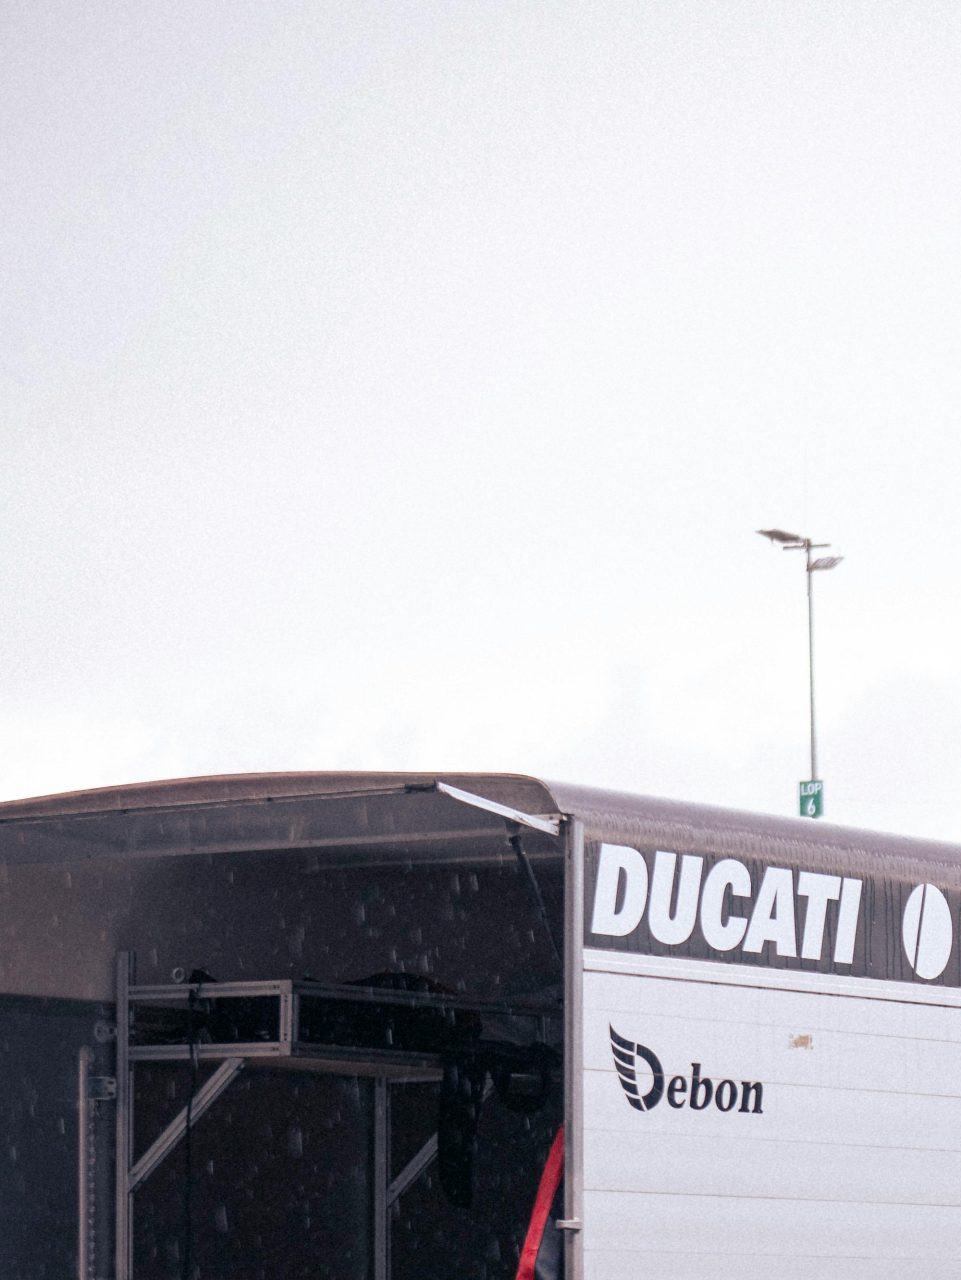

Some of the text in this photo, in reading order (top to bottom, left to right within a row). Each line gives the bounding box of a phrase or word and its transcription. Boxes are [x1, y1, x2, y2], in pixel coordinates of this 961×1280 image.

[807, 798, 816, 815] 6
[591, 843, 863, 964] DUCATI
[609, 1022, 764, 1114] Debon
